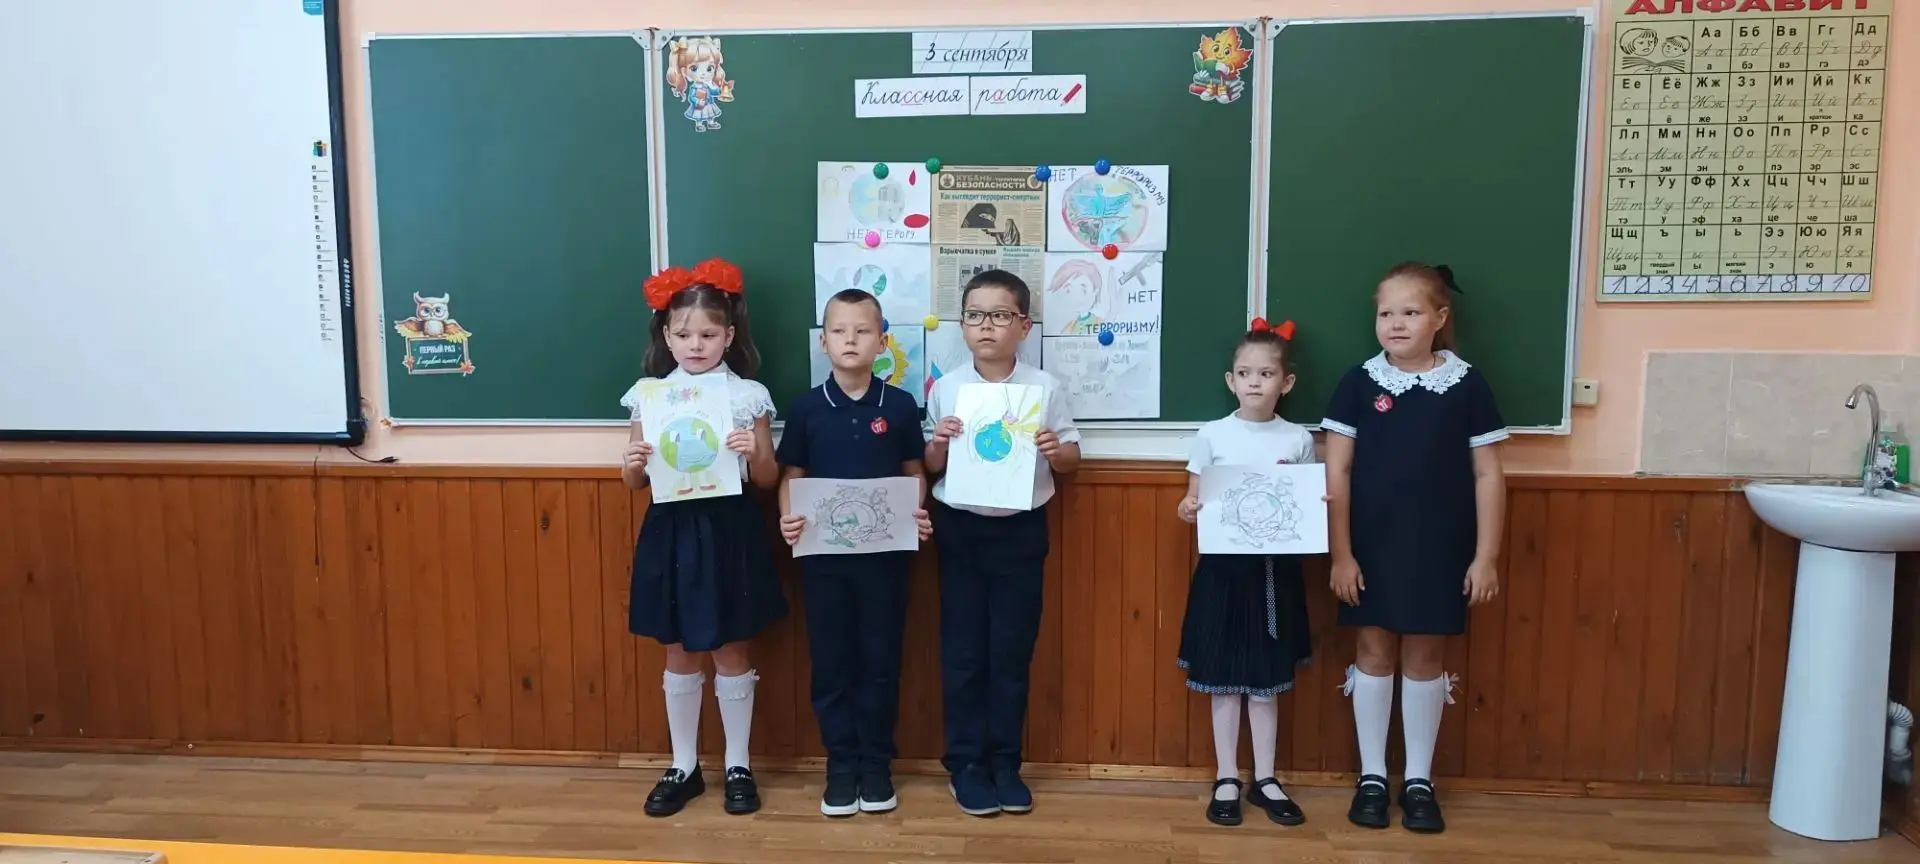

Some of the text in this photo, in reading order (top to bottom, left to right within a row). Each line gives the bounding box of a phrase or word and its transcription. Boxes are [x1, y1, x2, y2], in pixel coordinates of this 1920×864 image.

[925, 41, 1028, 69] 3 сентября
[862, 78, 1062, 111] Классная работа
[847, 228, 871, 240] НЕ
[1128, 290, 1158, 304] НЕТ
[1085, 314, 1159, 334] ТЕРРОРИЗМУ!
